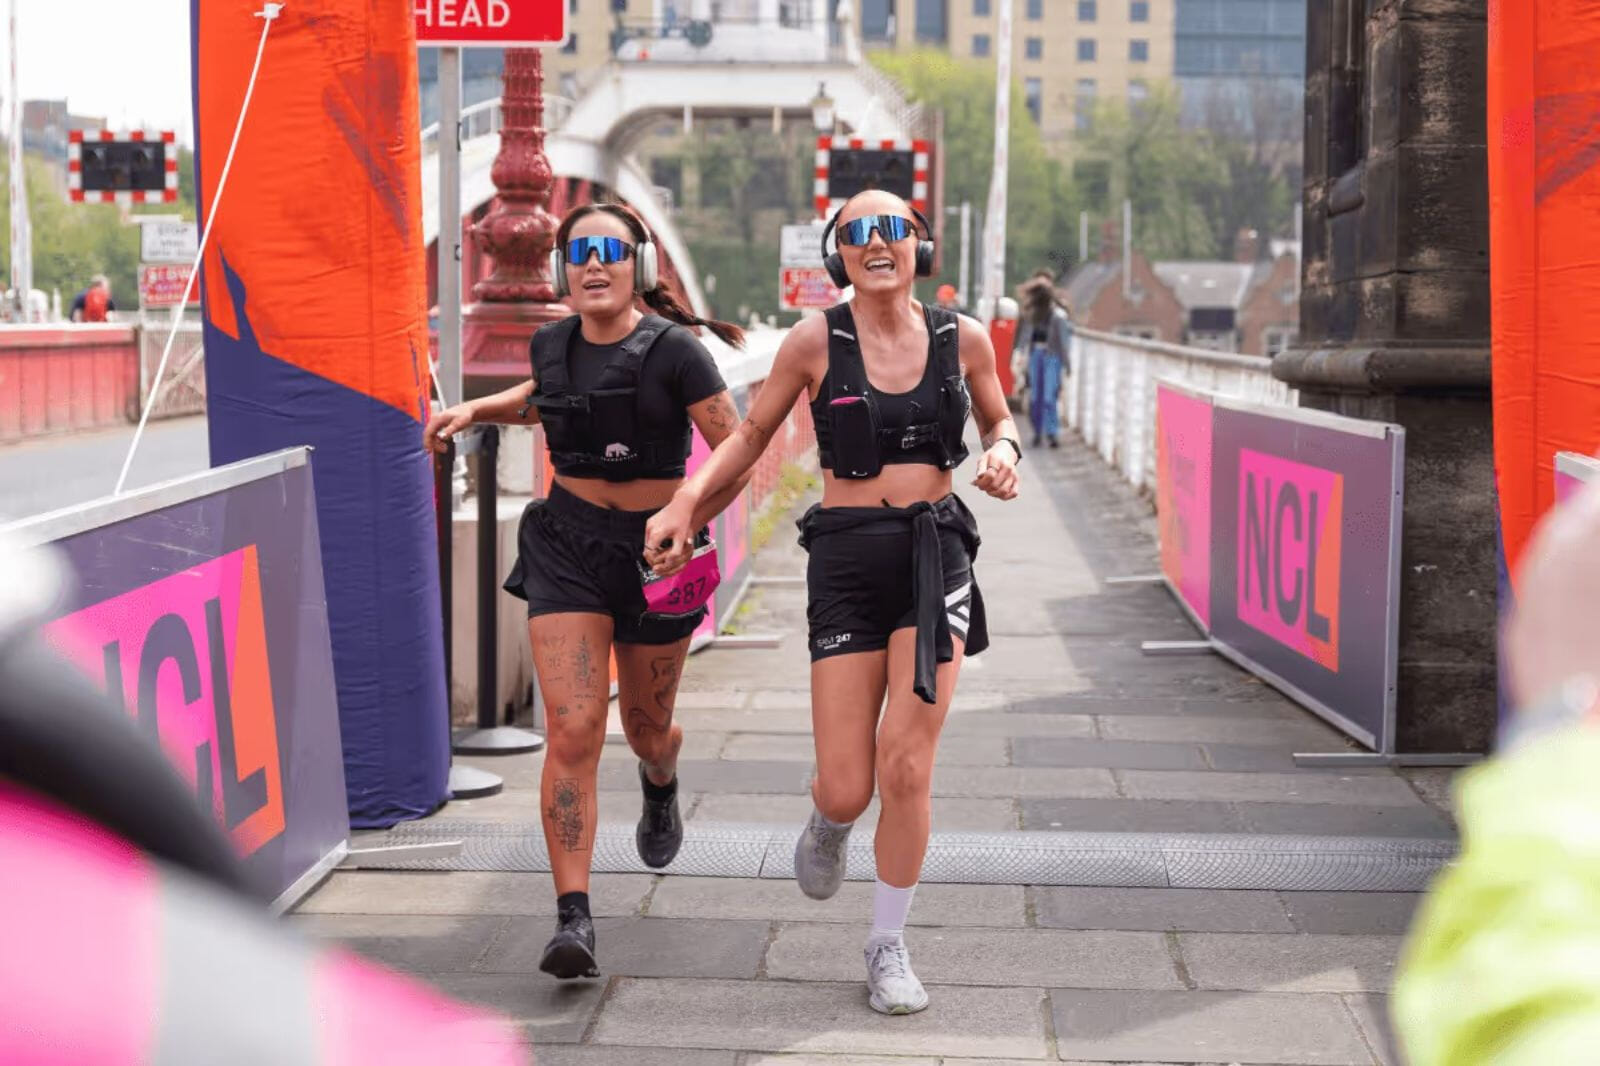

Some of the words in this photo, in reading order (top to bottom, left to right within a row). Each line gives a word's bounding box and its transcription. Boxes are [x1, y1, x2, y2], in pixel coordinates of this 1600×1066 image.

[836, 633, 851, 643] 247
[1244, 471, 1331, 644] NCL
[102, 596, 268, 830] CL
